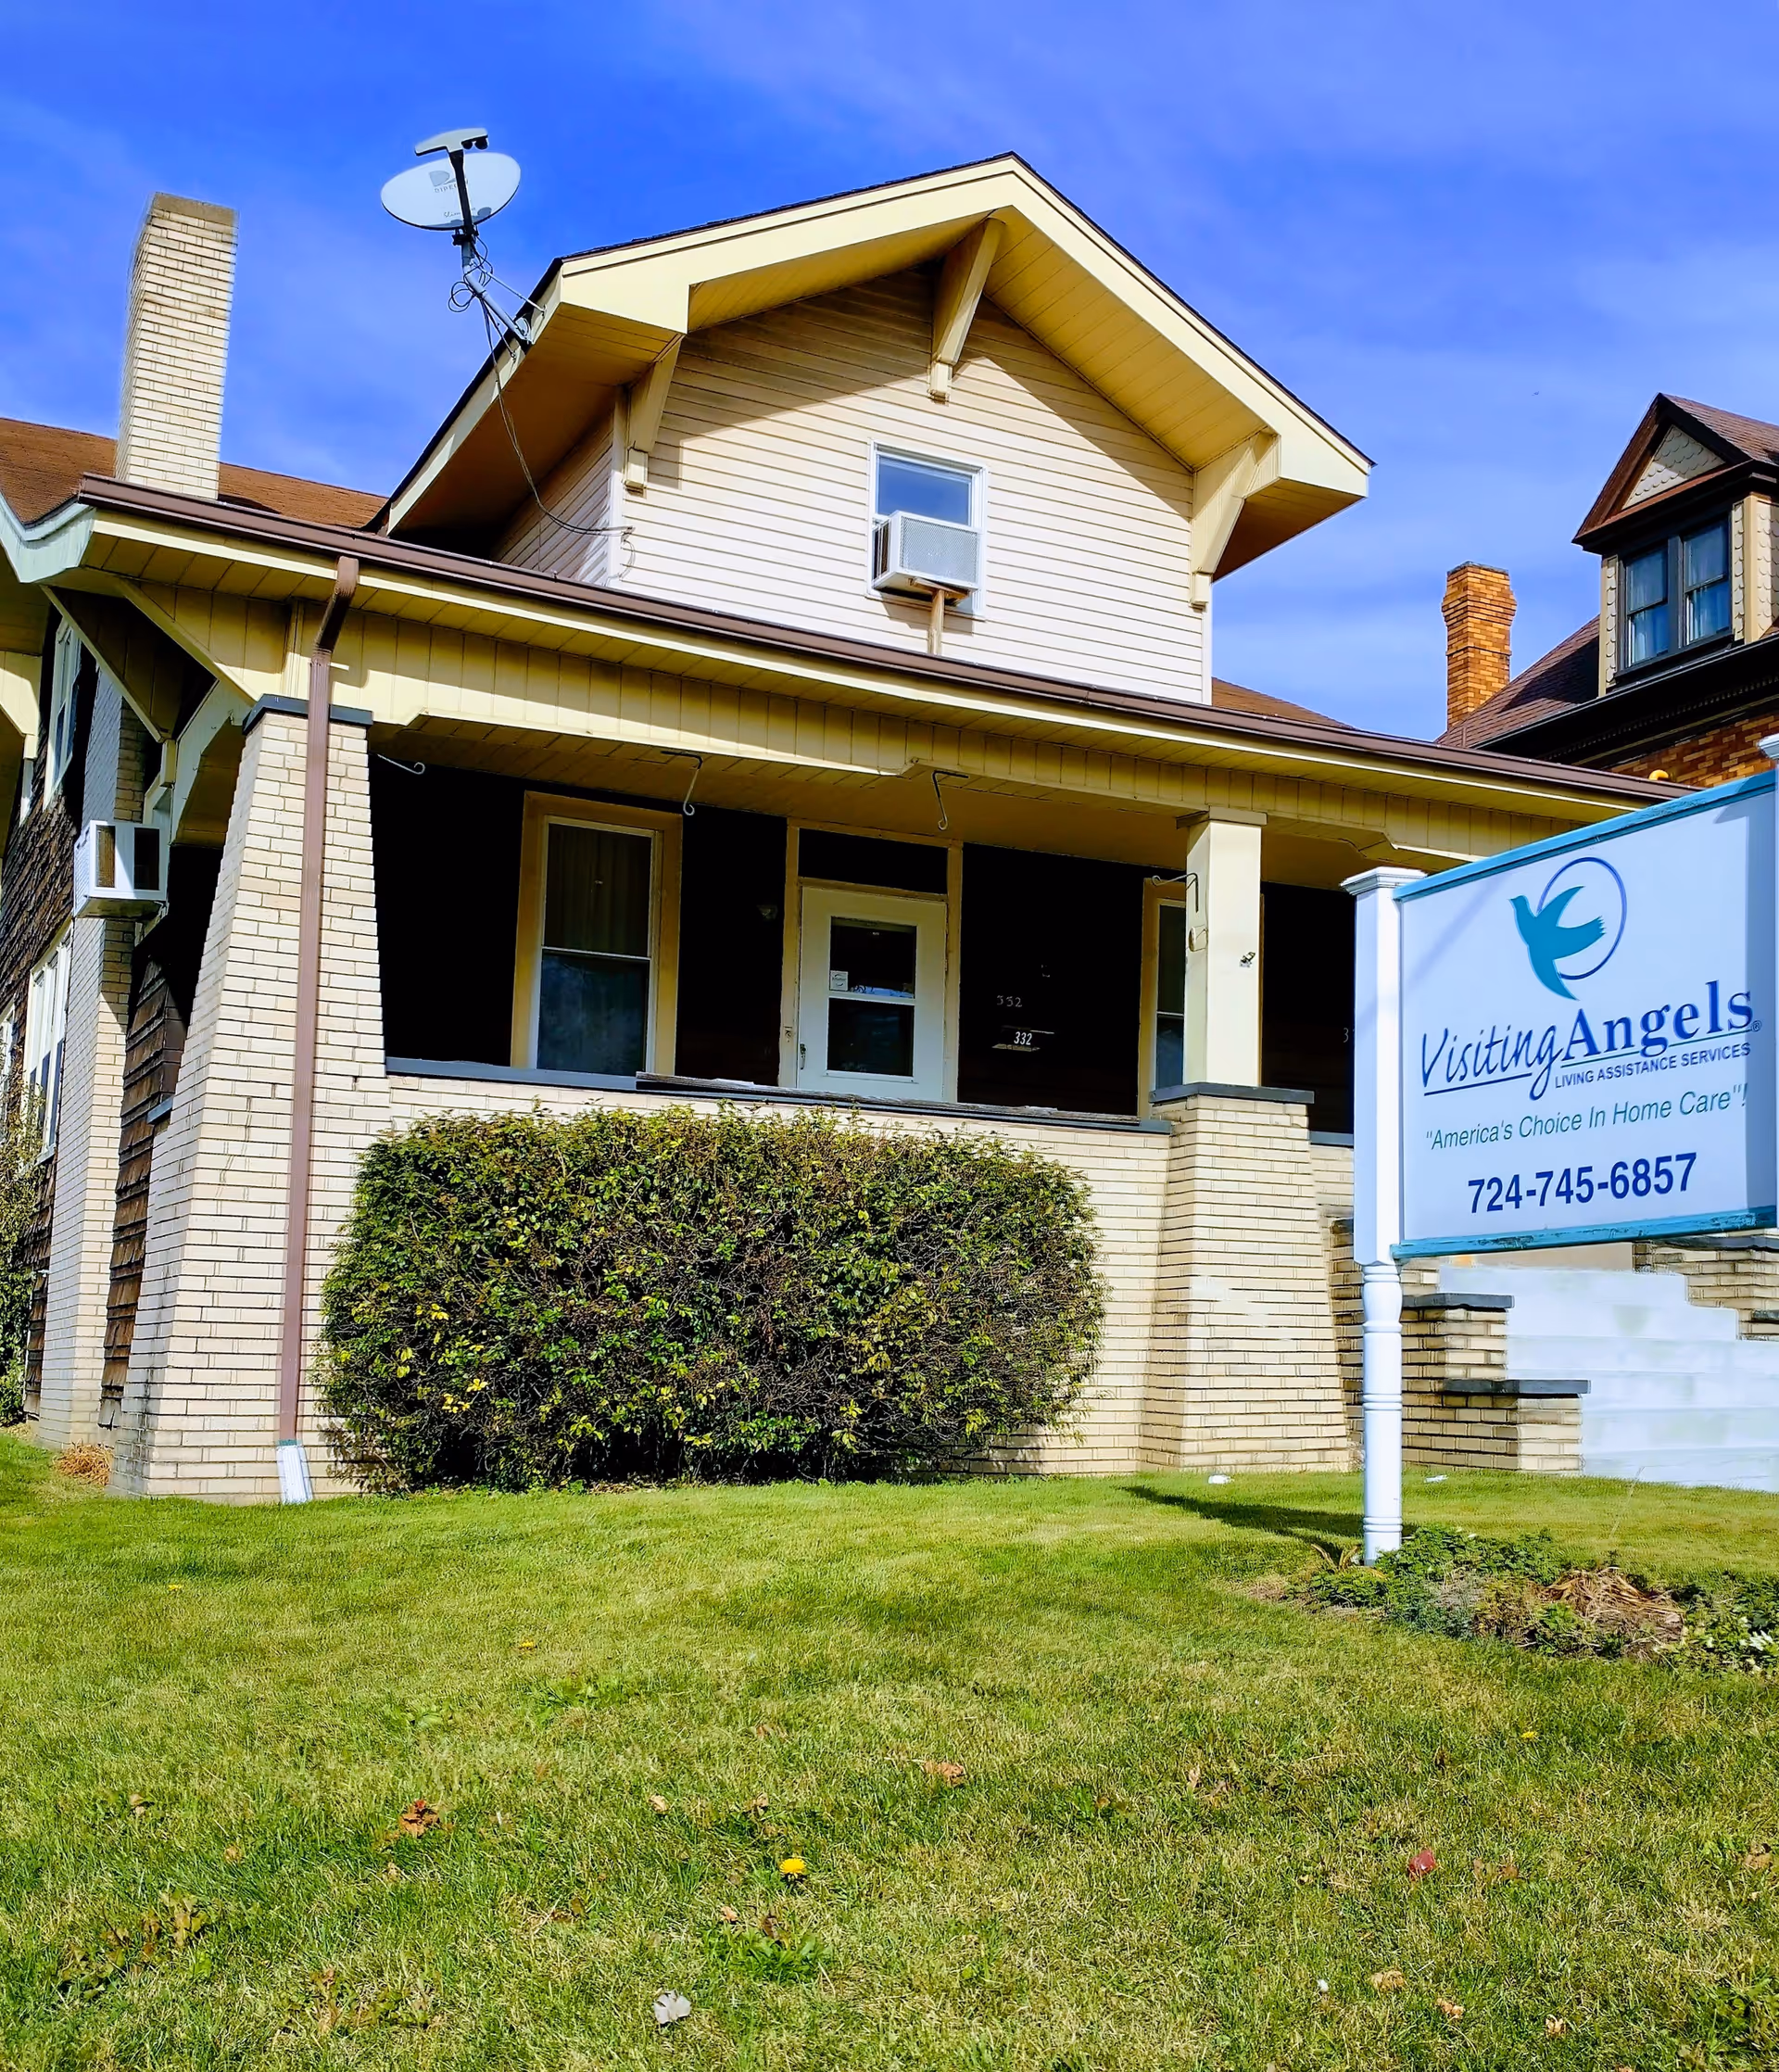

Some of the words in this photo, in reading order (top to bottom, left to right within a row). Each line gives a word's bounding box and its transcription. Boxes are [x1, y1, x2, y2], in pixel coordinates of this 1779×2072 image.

[1014, 1030, 1033, 1045] 332
[1422, 1024, 1564, 1101] Visiting
[1554, 1069, 1595, 1089] LIVING
[1596, 1055, 1677, 1081] ASSISTANCE
[1680, 1042, 1751, 1068] SERVICES
[1519, 1111, 1583, 1138] Choice
[1588, 1105, 1606, 1129] In
[1612, 1100, 1672, 1125] Home
[1468, 1152, 1697, 1214] 724-745-6857
